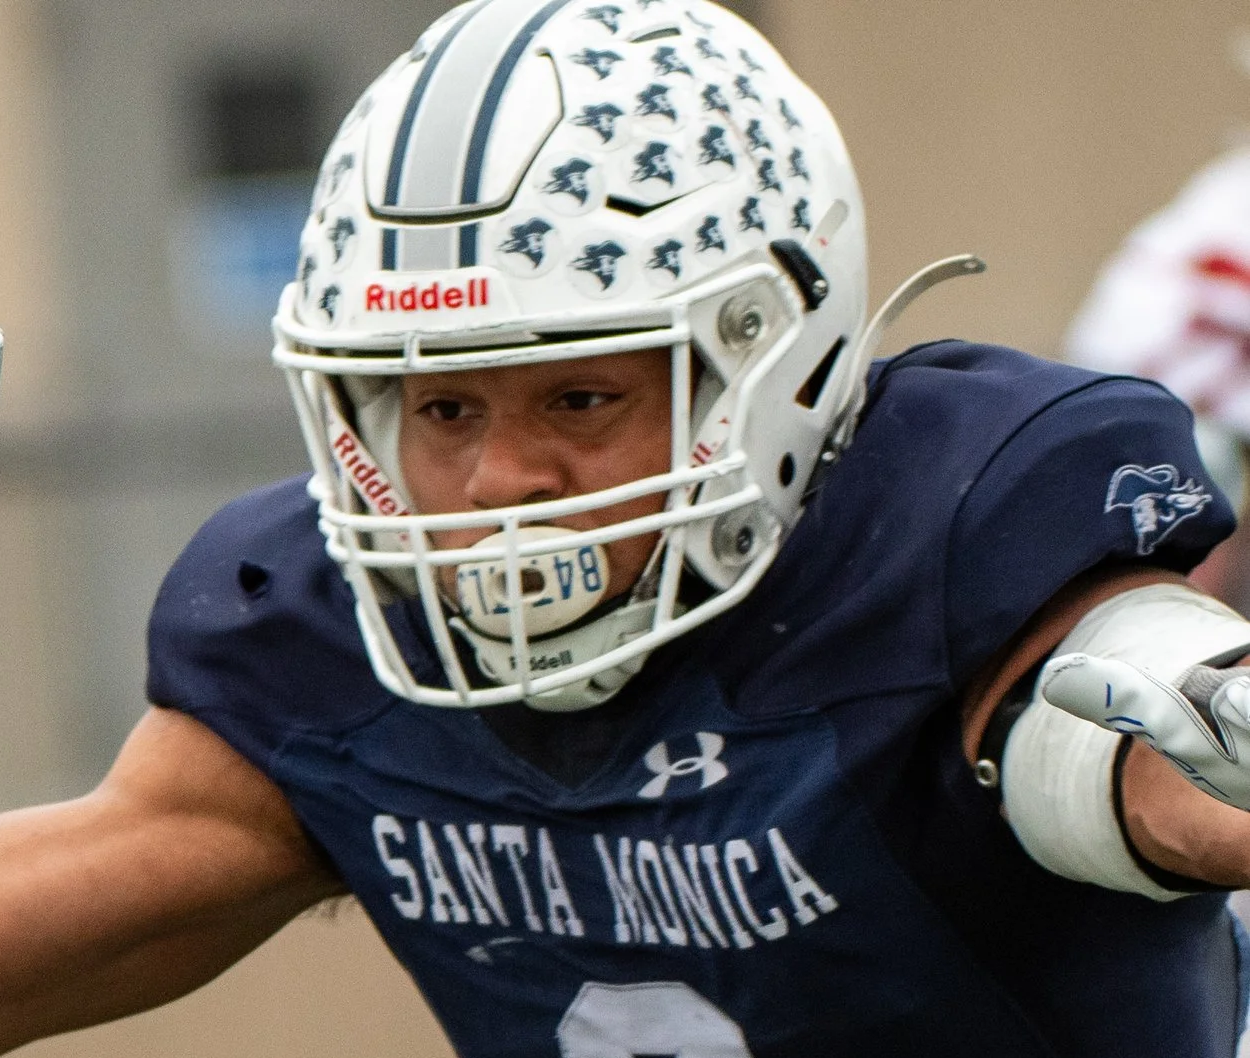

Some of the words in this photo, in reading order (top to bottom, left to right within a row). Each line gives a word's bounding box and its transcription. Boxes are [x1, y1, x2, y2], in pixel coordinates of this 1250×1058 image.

[366, 279, 488, 311] Riddell
[334, 431, 411, 516] Ridde
[371, 814, 584, 937] SANTA
[595, 828, 839, 949] MONICA
